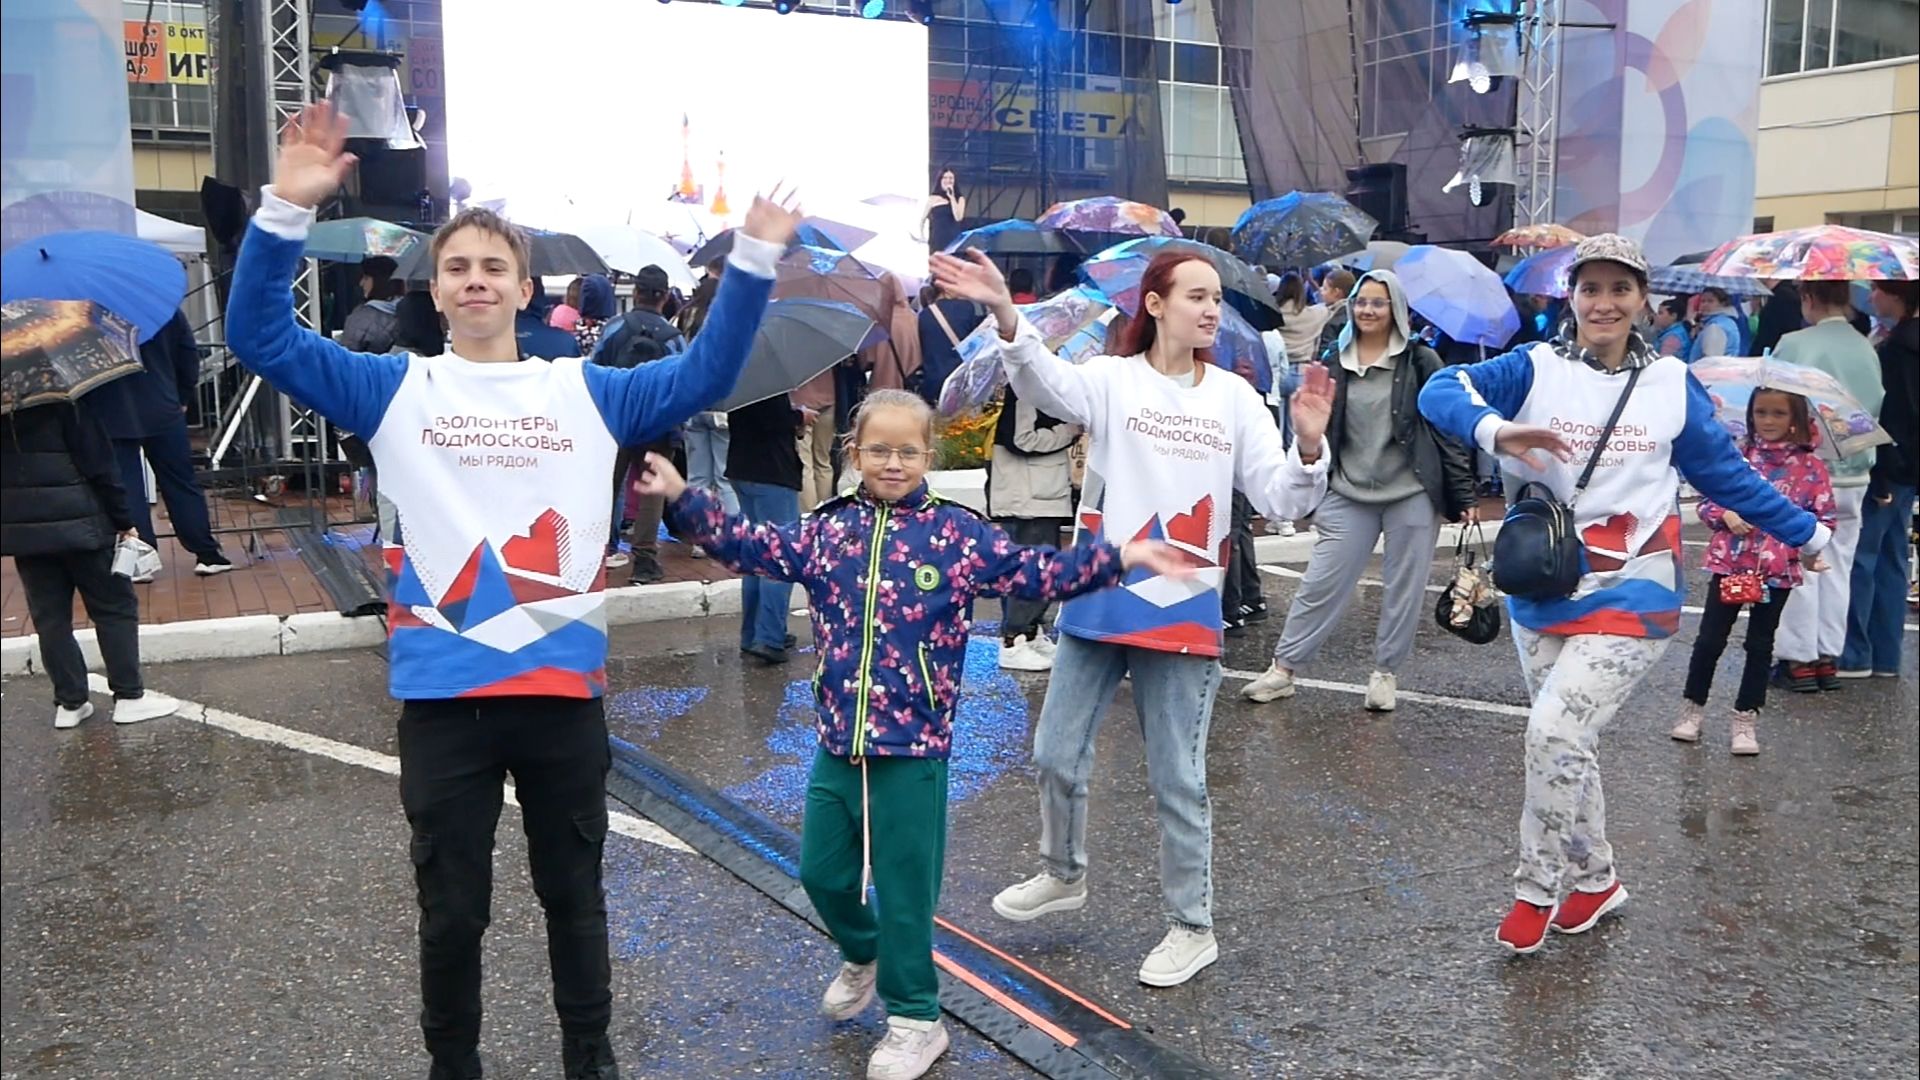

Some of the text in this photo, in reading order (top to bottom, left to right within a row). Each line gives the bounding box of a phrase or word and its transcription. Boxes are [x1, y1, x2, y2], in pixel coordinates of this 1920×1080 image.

[168, 26, 176, 37] 8
[125, 41, 158, 57] ШОУ
[435, 415, 559, 432] ВОЛОНТЕРЫ
[1140, 407, 1226, 435] ВОЛОНТЕРЫ
[1549, 416, 1647, 437] ВОЛОНЕРЫ
[421, 429, 574, 452] ПОДМОСКОВЬЯ
[1125, 416, 1232, 454] ПОДМОСКОВЬЯ
[459, 455, 538, 468] МЫ РЯДОМ
[1583, 456, 1624, 467] РДОМ
